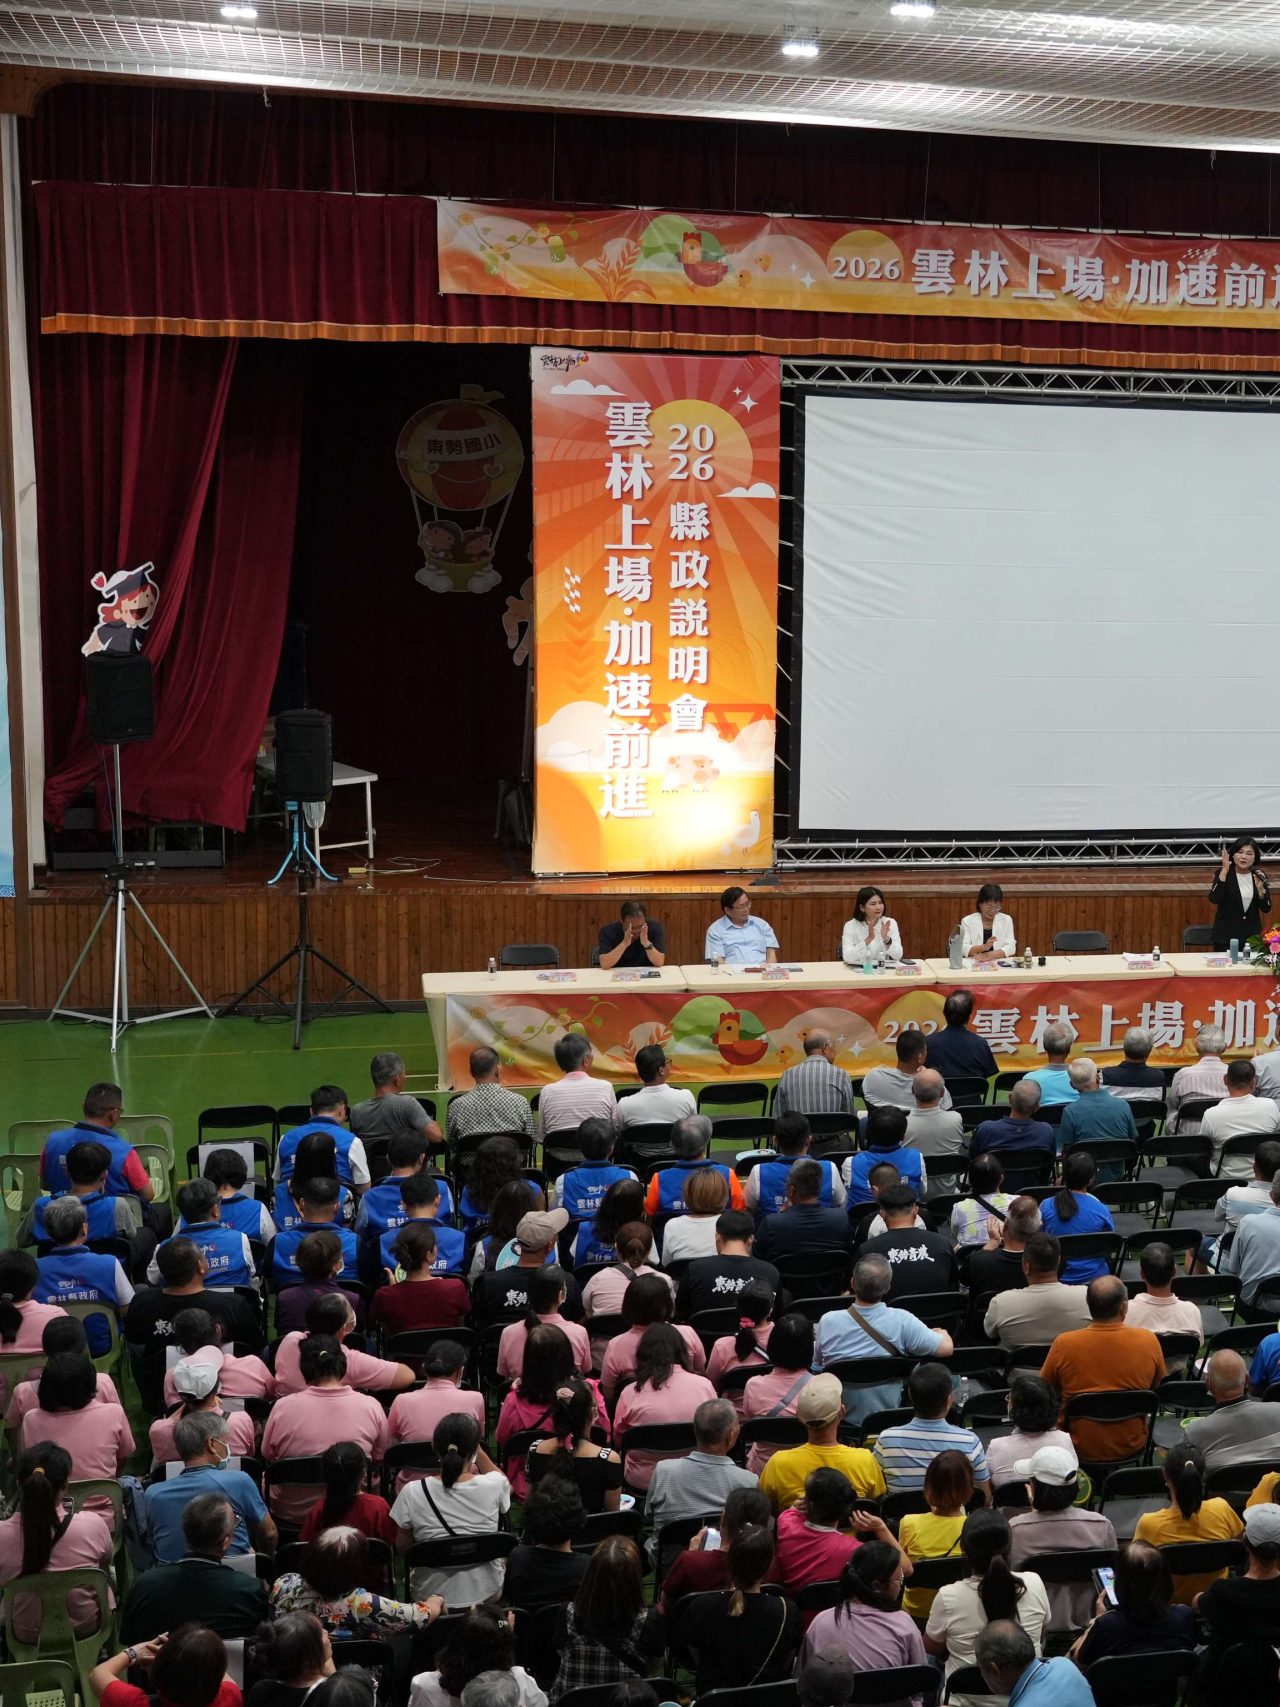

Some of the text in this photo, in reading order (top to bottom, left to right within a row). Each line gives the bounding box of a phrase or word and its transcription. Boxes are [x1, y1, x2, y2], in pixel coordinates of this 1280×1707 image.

[832, 255, 900, 280] 2026
[427, 432, 502, 455] 東勢國小
[884, 1020, 946, 1043] 22
[207, 1255, 230, 1268] 政府
[712, 1275, 755, 1294] 東勢青
